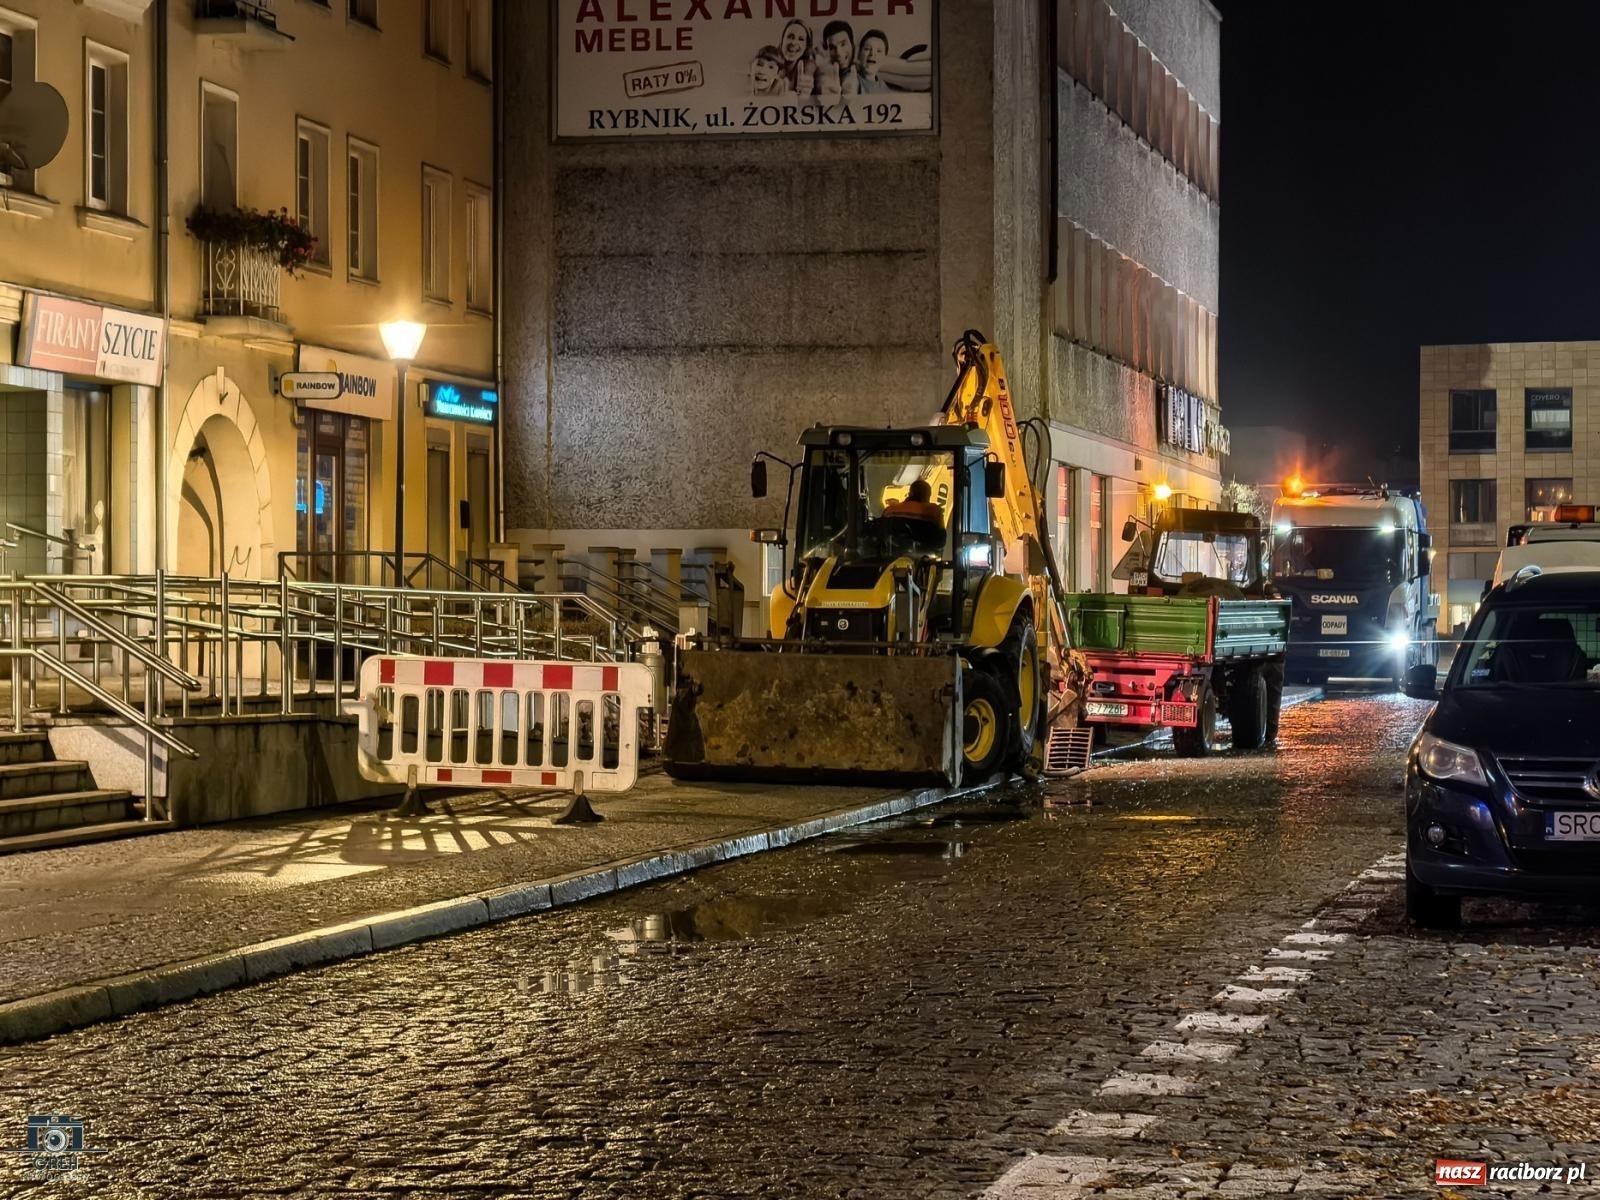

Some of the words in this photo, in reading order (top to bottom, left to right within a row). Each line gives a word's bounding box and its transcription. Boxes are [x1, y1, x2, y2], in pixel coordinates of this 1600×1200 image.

[575, 0, 915, 23] ALEXANDER
[575, 27, 694, 53] MEBLE
[631, 73, 670, 92] RATY
[675, 68, 698, 85] 0%
[587, 107, 698, 131] RYBNIK,
[705, 107, 736, 127] ul.
[742, 102, 856, 126] ŻORSKA
[862, 103, 904, 124] 192
[37, 310, 100, 352] FIRANY
[101, 321, 158, 361] SZYCIE
[296, 382, 336, 390] RAINBOW
[339, 372, 377, 398] RAINBOW
[1311, 594, 1359, 604] SCANIA
